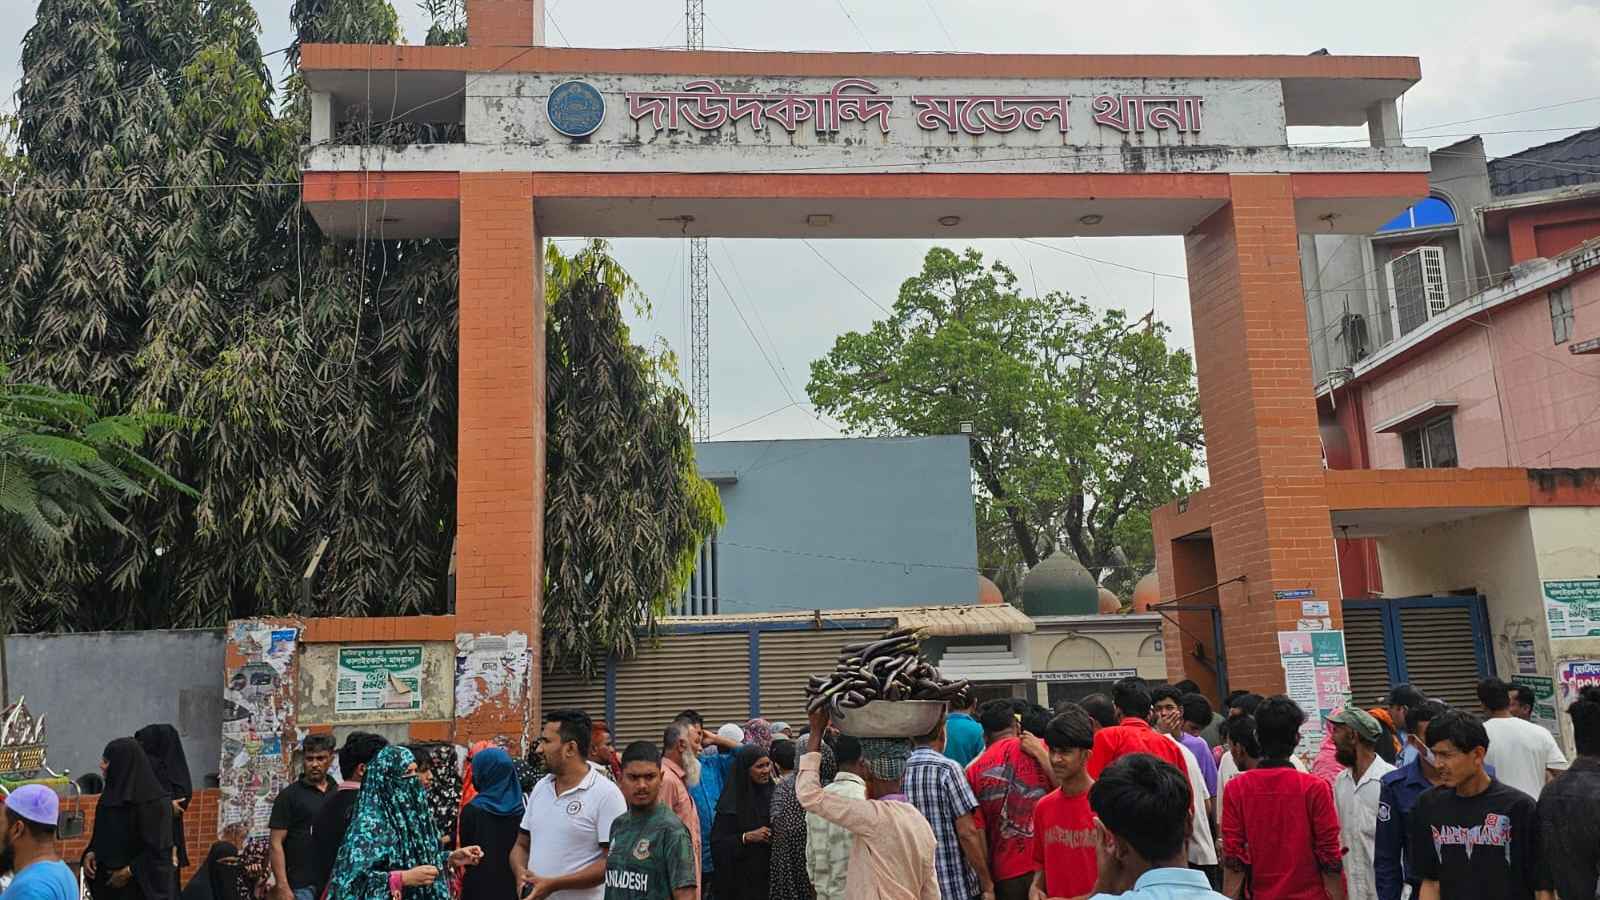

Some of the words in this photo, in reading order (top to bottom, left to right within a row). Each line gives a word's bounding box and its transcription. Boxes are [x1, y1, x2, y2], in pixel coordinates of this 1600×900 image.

[624, 78, 893, 133] দাউদকান্দি
[911, 95, 1072, 134] মডেল
[1091, 95, 1205, 133] থানা
